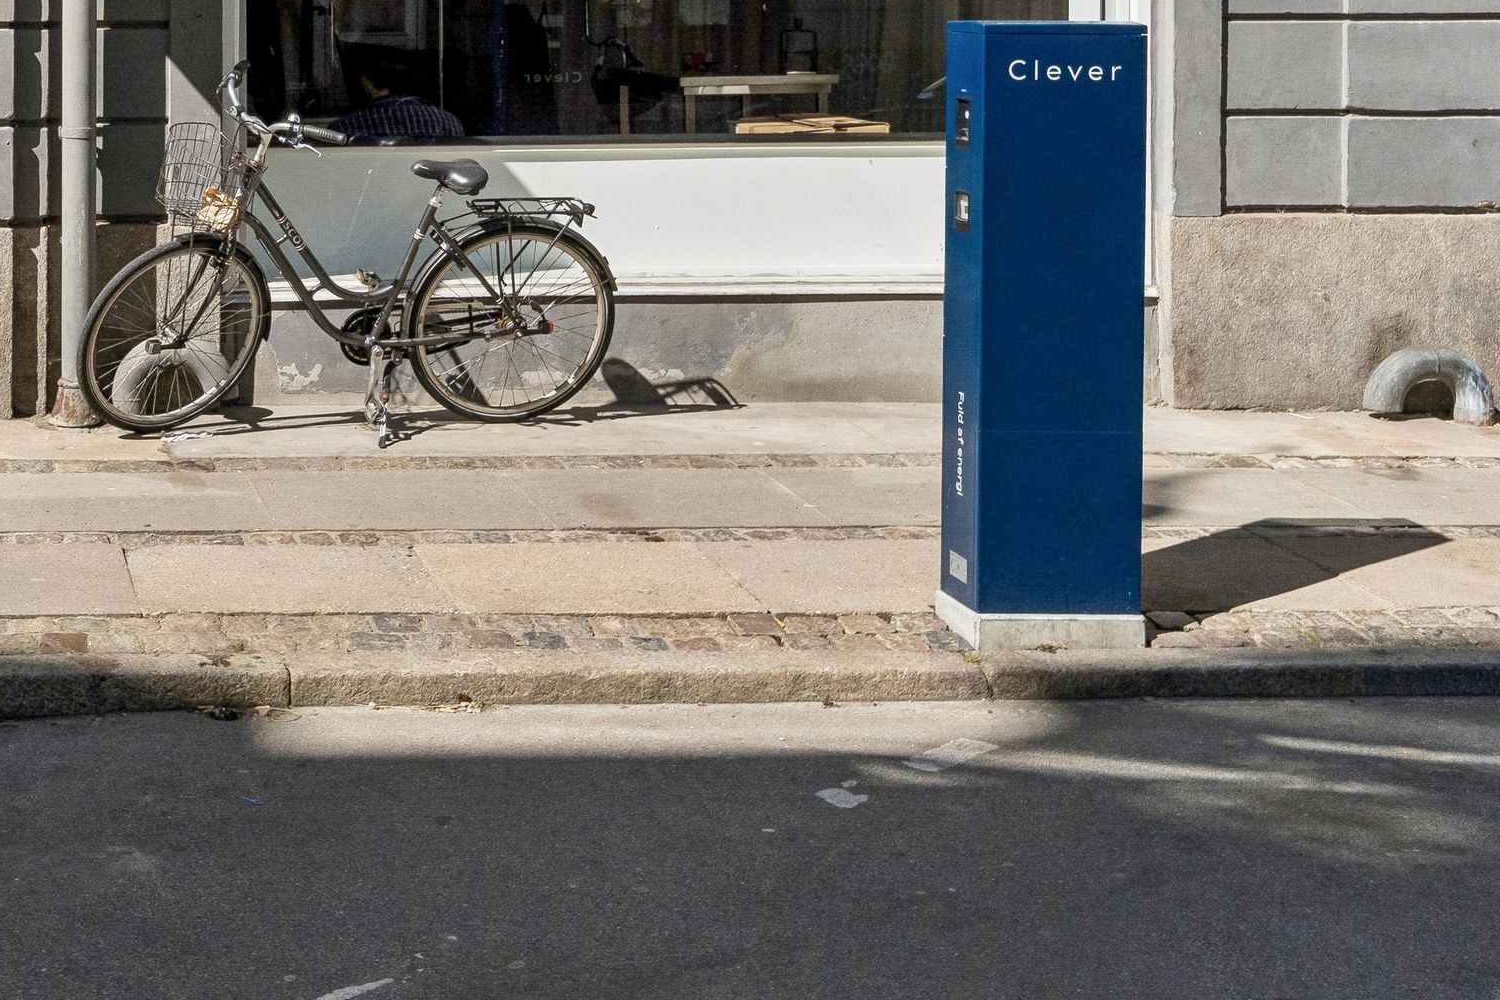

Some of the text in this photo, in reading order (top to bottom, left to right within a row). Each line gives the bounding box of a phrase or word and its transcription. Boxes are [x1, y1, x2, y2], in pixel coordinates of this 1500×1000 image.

[1008, 59, 1122, 82] Clever
[282, 221, 301, 244] SCO
[957, 391, 965, 425] Fuld
[955, 447, 964, 497] energi
